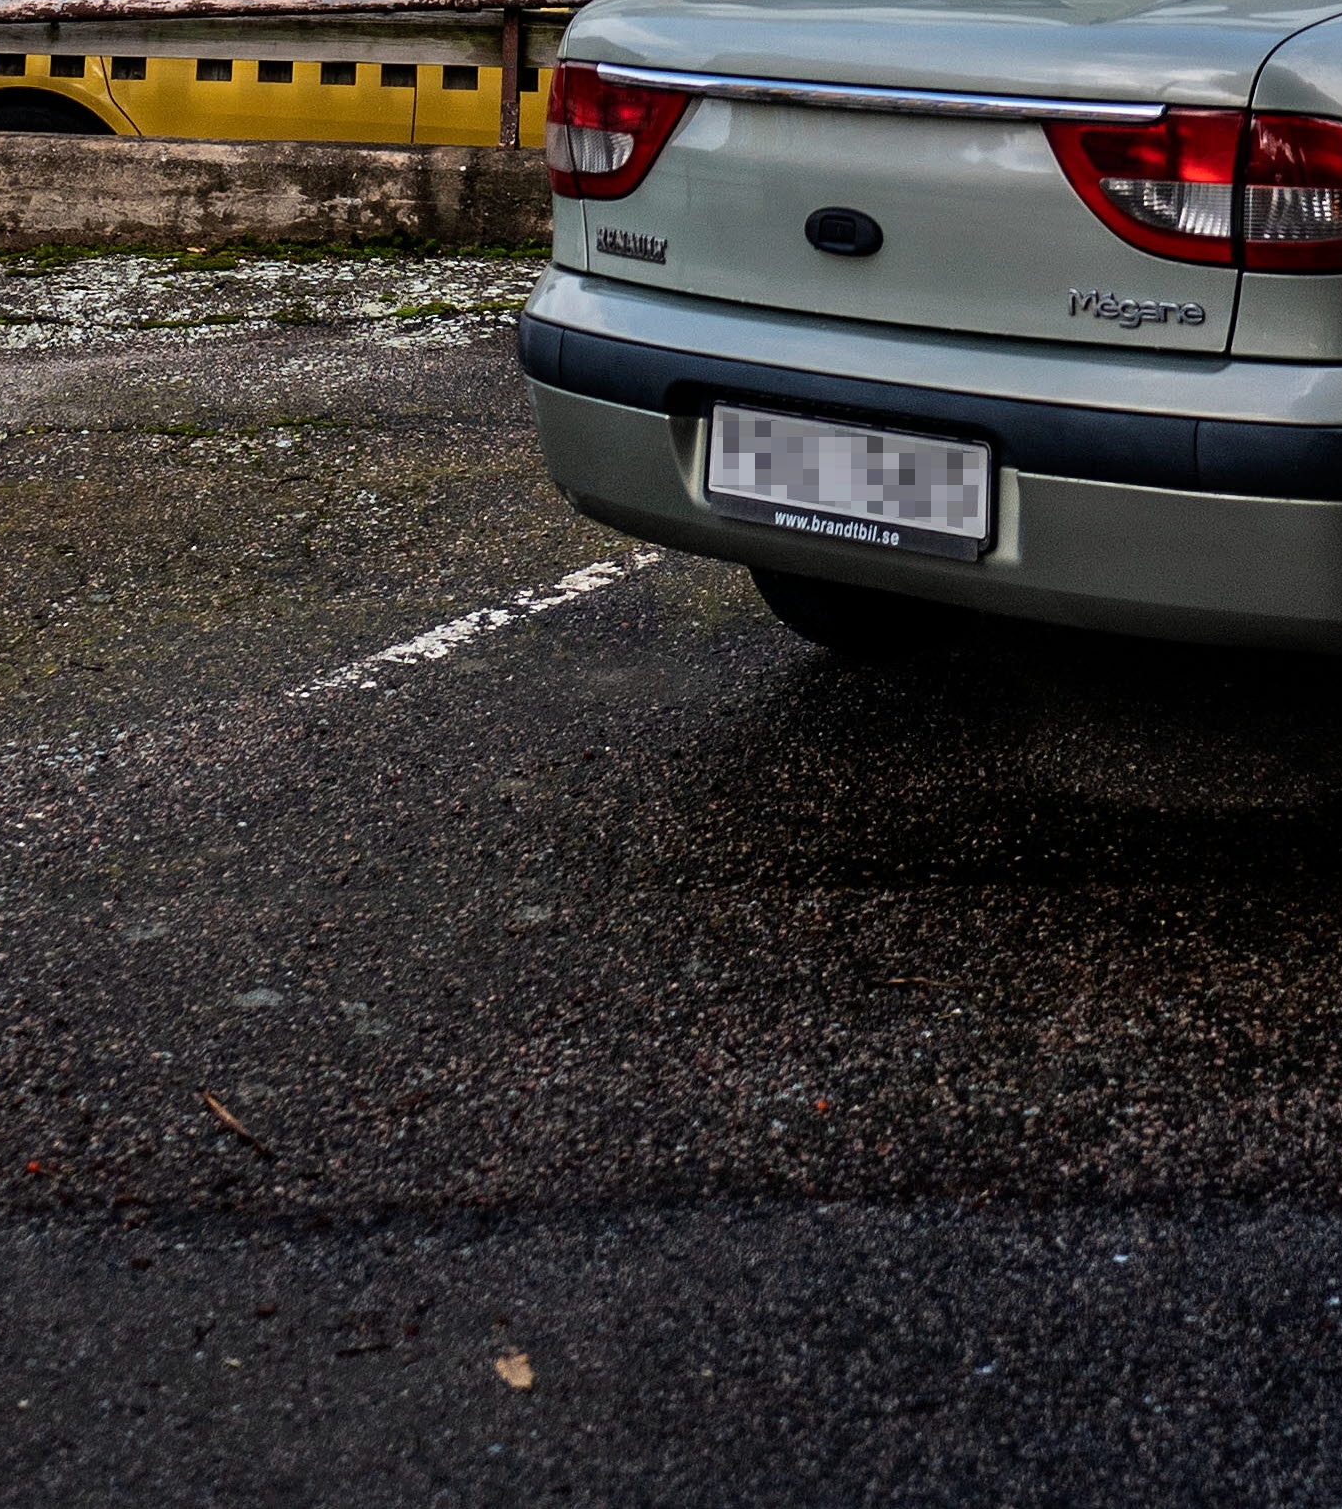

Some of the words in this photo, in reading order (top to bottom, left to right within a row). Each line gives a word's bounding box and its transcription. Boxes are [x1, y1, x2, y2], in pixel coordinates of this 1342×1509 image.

[596, 226, 668, 265] RENAULT
[1068, 287, 1206, 329] Mégane
[774, 511, 899, 546] www.brandtbil.se
